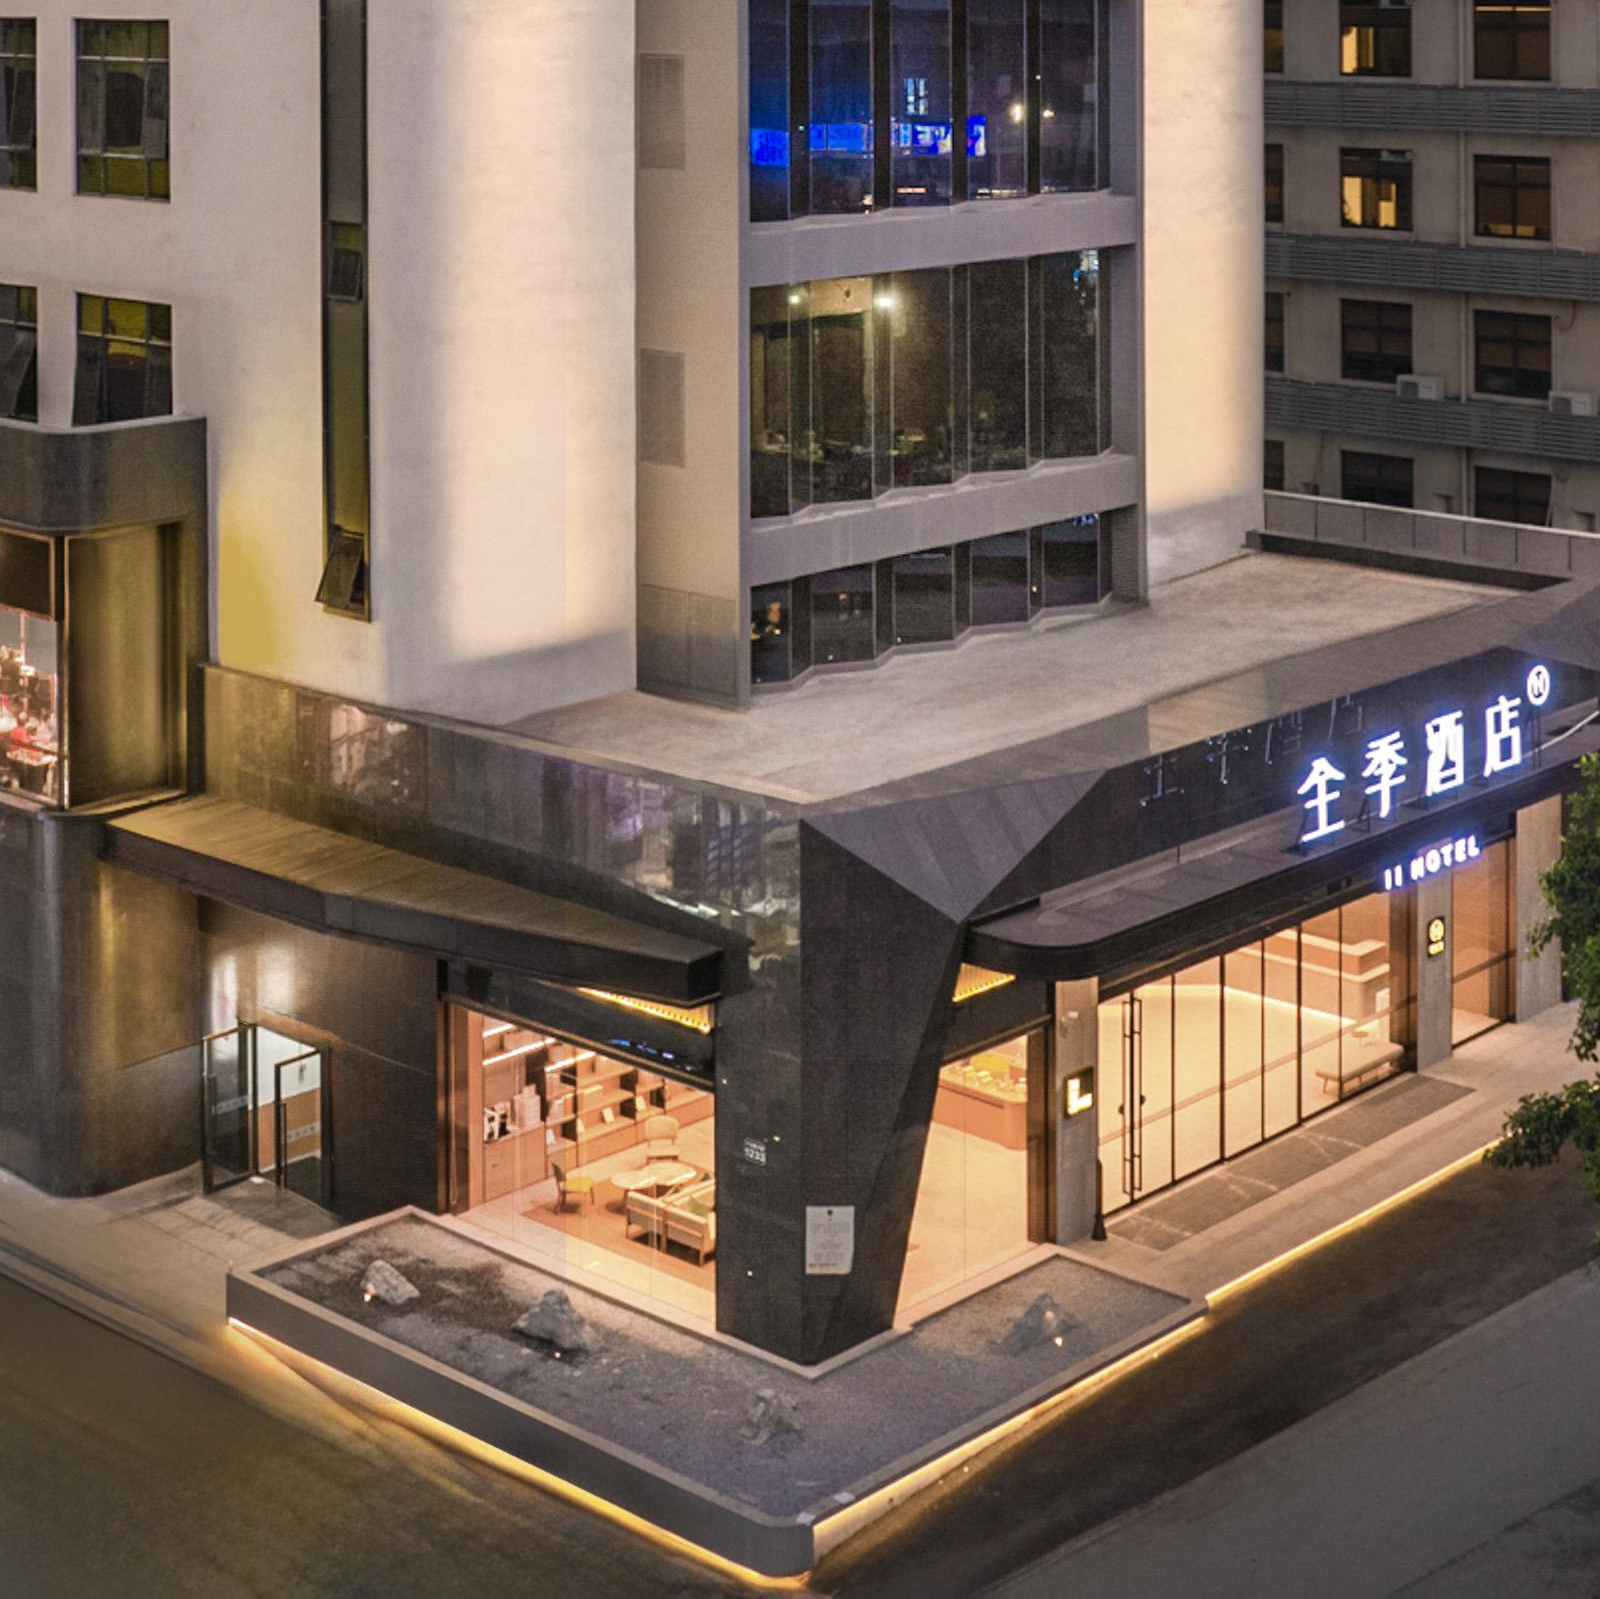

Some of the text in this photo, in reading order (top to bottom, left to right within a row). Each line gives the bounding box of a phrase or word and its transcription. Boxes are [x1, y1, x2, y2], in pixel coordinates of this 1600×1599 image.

[1297, 695, 1522, 843] 全季酒店
[1410, 834, 1480, 881] HOTEL
